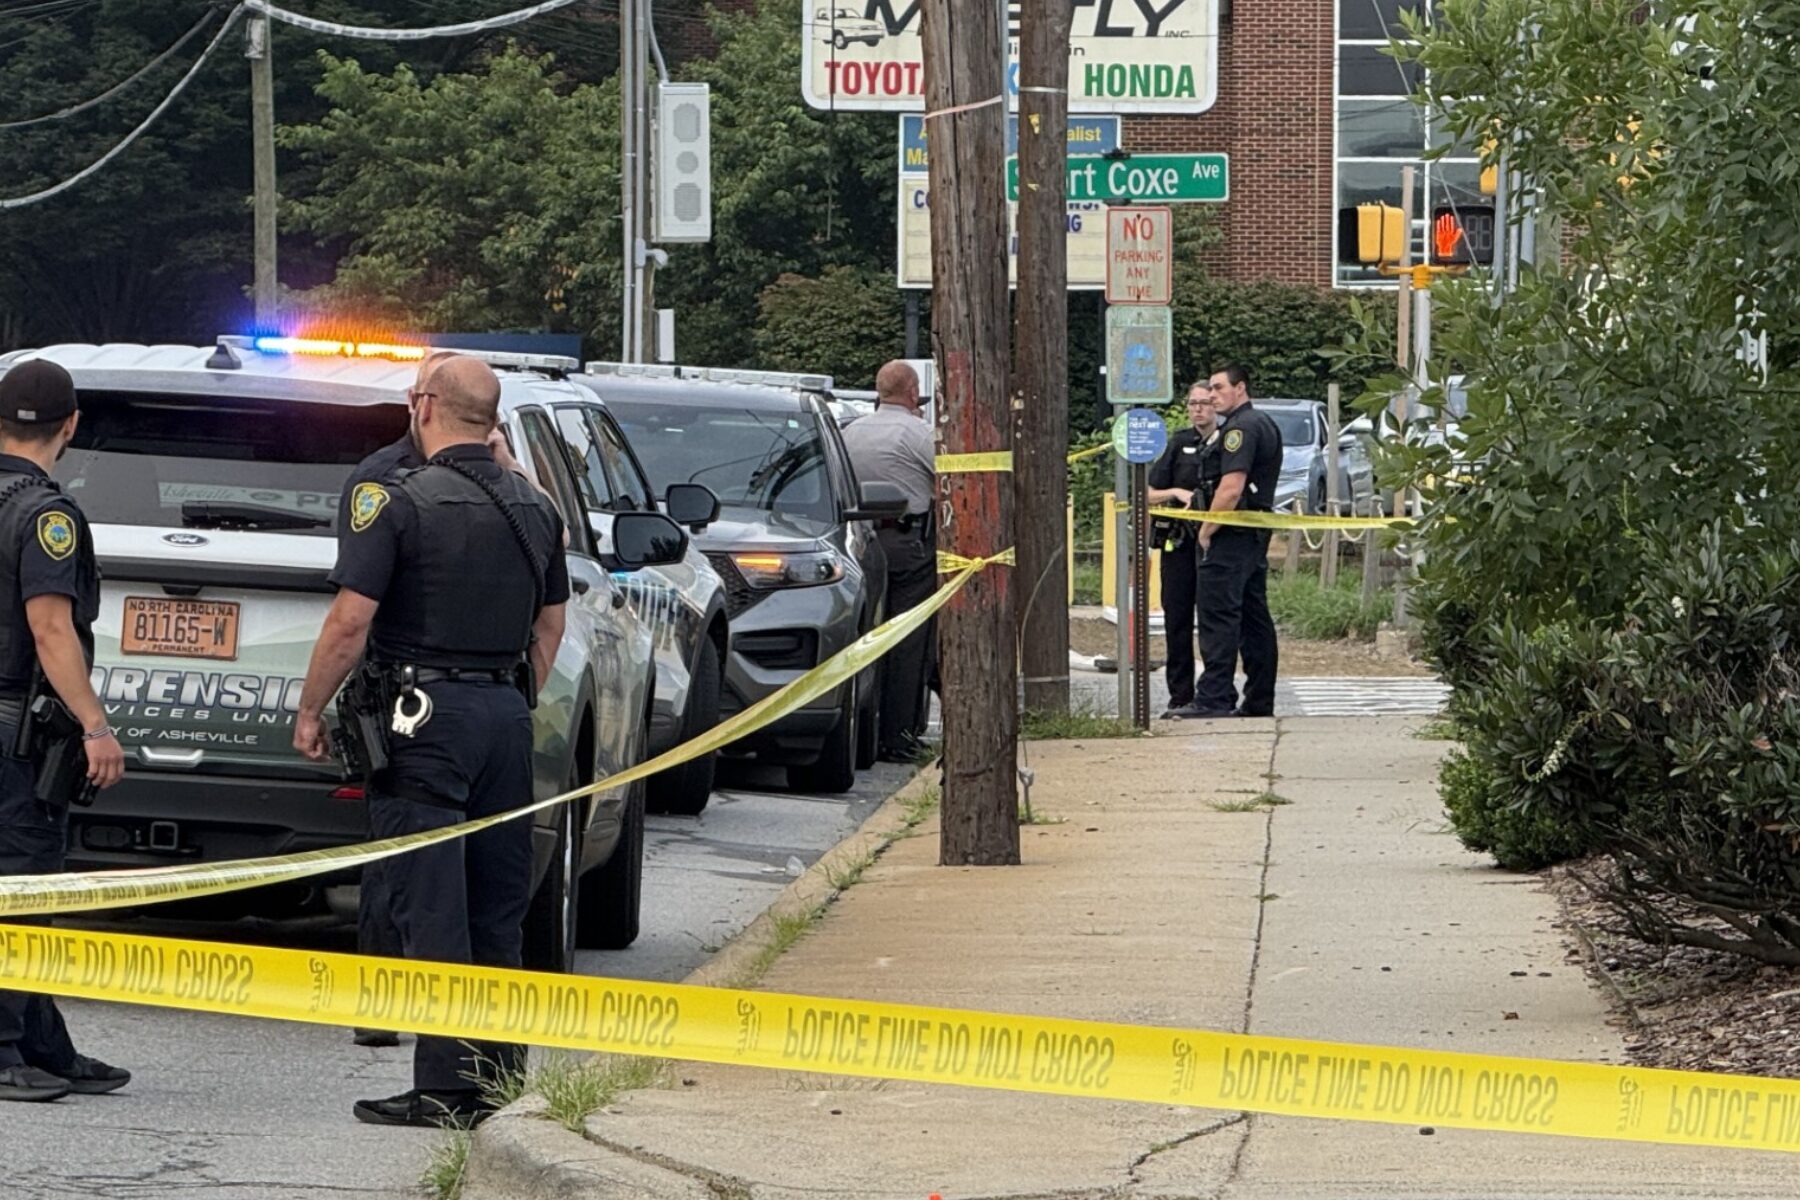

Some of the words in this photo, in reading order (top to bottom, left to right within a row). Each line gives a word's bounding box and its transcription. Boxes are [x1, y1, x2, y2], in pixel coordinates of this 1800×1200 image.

[824, 61, 925, 95] TOYOT
[1084, 63, 1196, 98] HONDA
[1108, 162, 1179, 196] Coxe
[1192, 161, 1220, 179] Ave
[1123, 217, 1153, 241] NO
[1114, 249, 1164, 263] PARKING
[1126, 267, 1150, 279] ANY
[1126, 285, 1152, 298] TIME
[170, 533, 199, 544] Ford
[129, 601, 171, 612] NORTH
[176, 603, 234, 616] CAROLINA
[134, 612, 227, 646] 81165-W
[152, 644, 205, 653] PERMANENT
[104, 704, 210, 720] VICES
[232, 713, 292, 724] UNI
[127, 728, 152, 738] OF
[158, 730, 258, 745] ASHEVILLE
